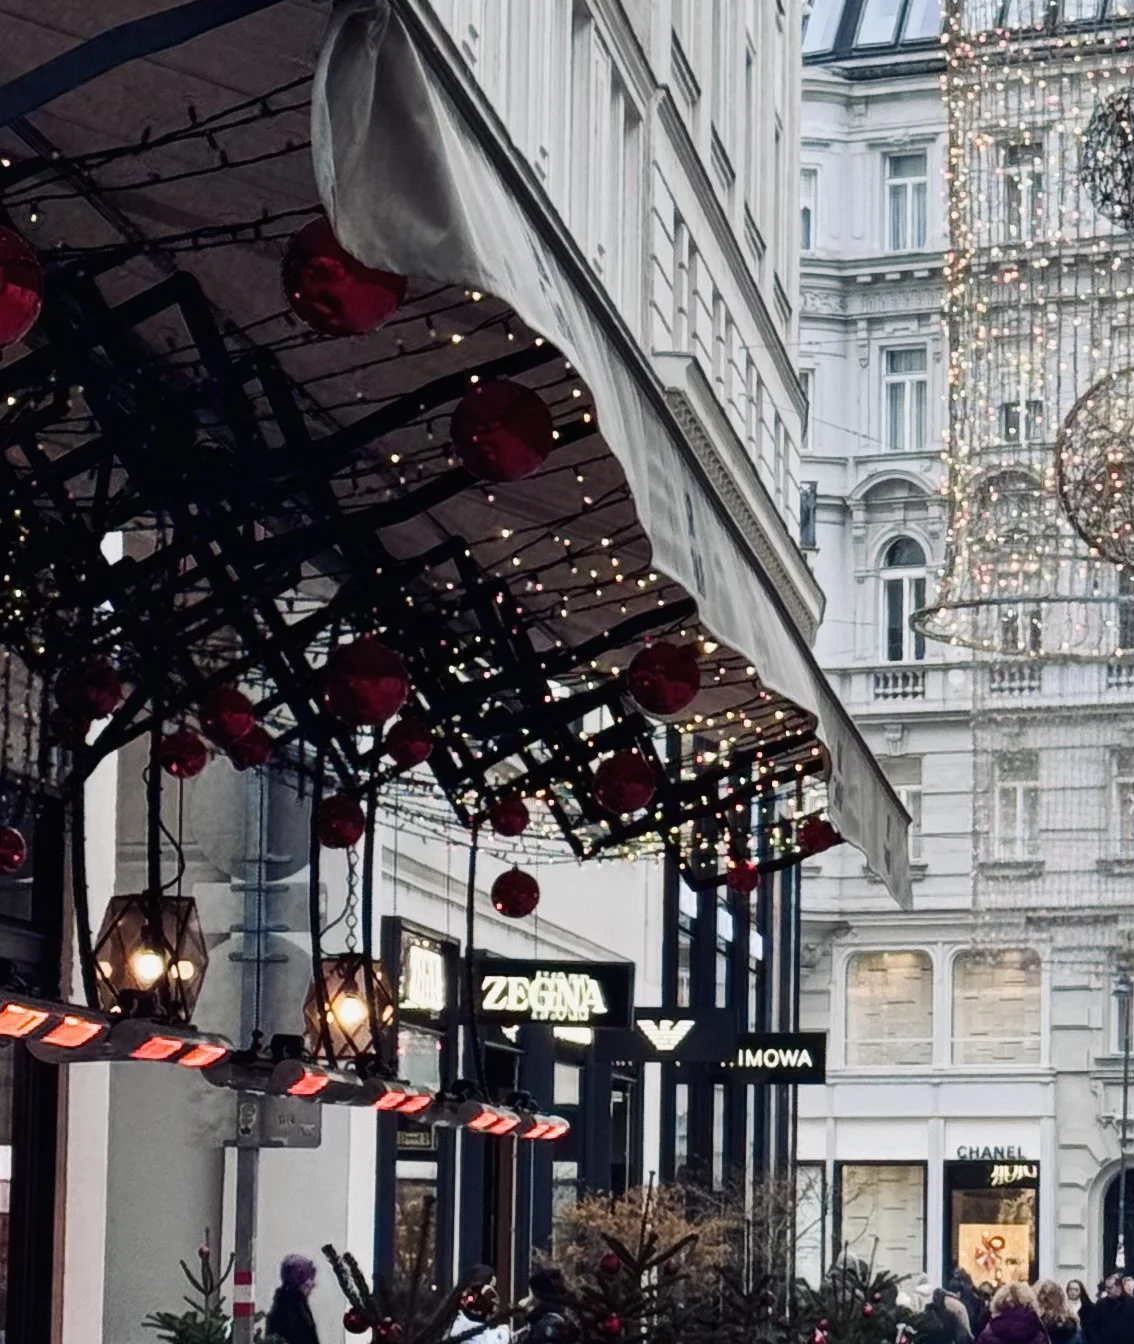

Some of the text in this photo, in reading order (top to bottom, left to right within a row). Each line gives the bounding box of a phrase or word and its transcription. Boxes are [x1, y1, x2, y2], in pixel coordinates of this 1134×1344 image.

[481, 975, 608, 1014] ZEGNA
[738, 1048, 813, 1068] IMOWA
[957, 1145, 1026, 1160] CHANEL
